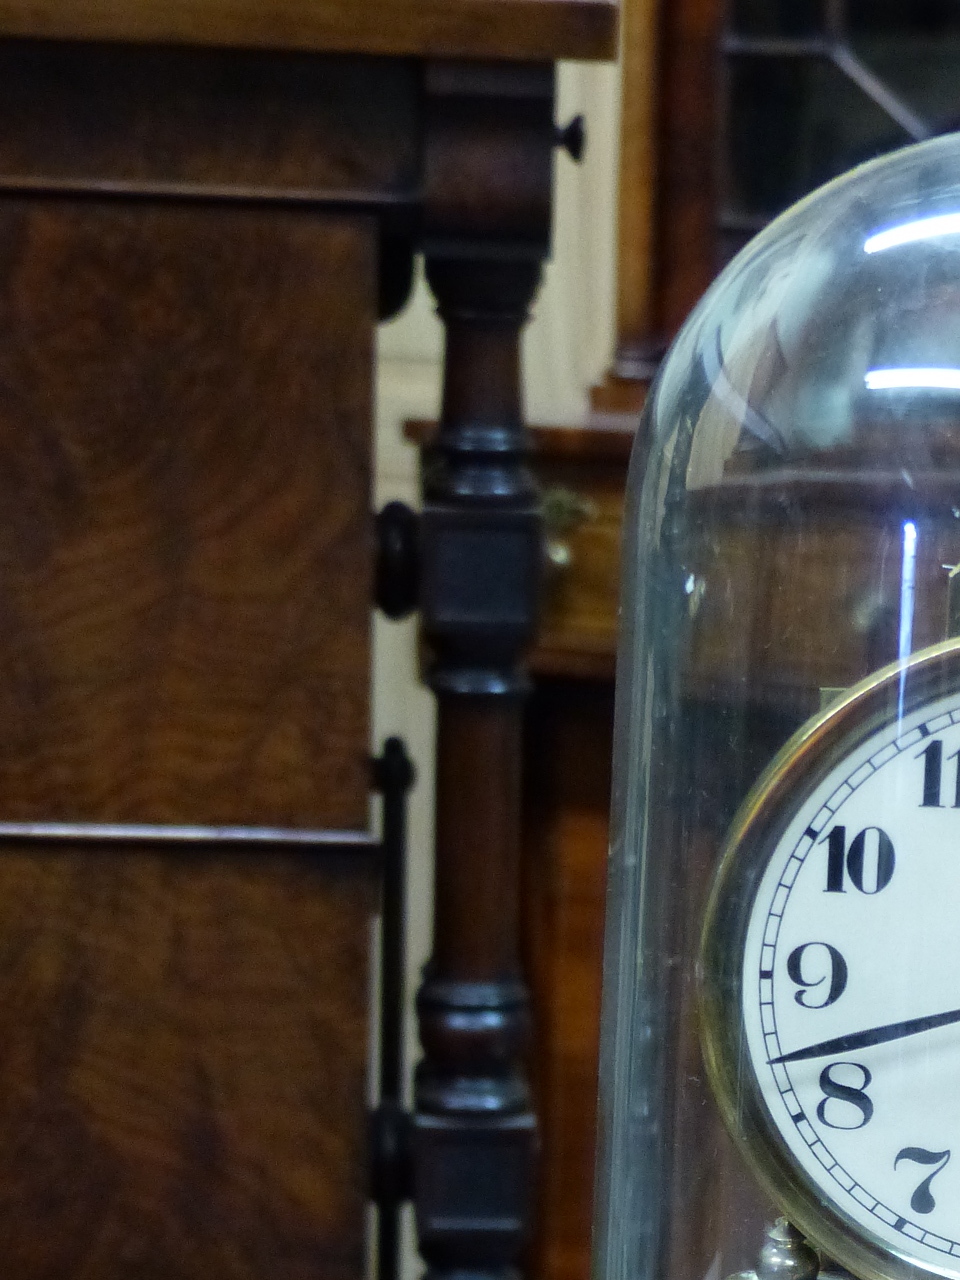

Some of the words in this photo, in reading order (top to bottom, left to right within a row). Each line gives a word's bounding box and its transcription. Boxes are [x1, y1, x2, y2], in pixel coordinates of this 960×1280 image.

[818, 826, 896, 895] 10
[786, 942, 849, 1009] 9
[816, 1062, 874, 1131] 8
[893, 1147, 951, 1215] 7
